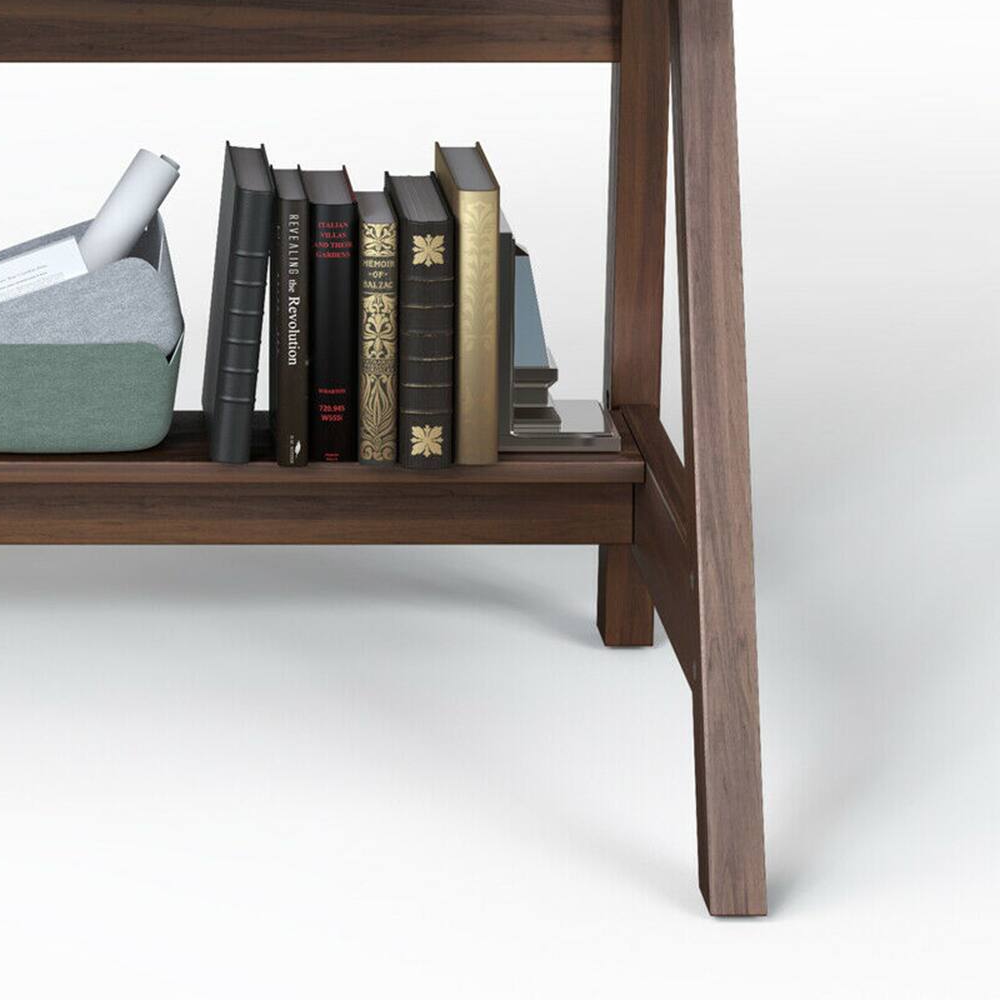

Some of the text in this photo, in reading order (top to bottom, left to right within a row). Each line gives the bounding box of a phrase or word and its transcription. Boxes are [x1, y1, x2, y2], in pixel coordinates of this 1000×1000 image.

[317, 221, 349, 230] ITALIAN
[320, 231, 348, 240] VILLAS
[315, 251, 351, 259] GARDENS
[288, 213, 301, 366] REVEALING the Revolution
